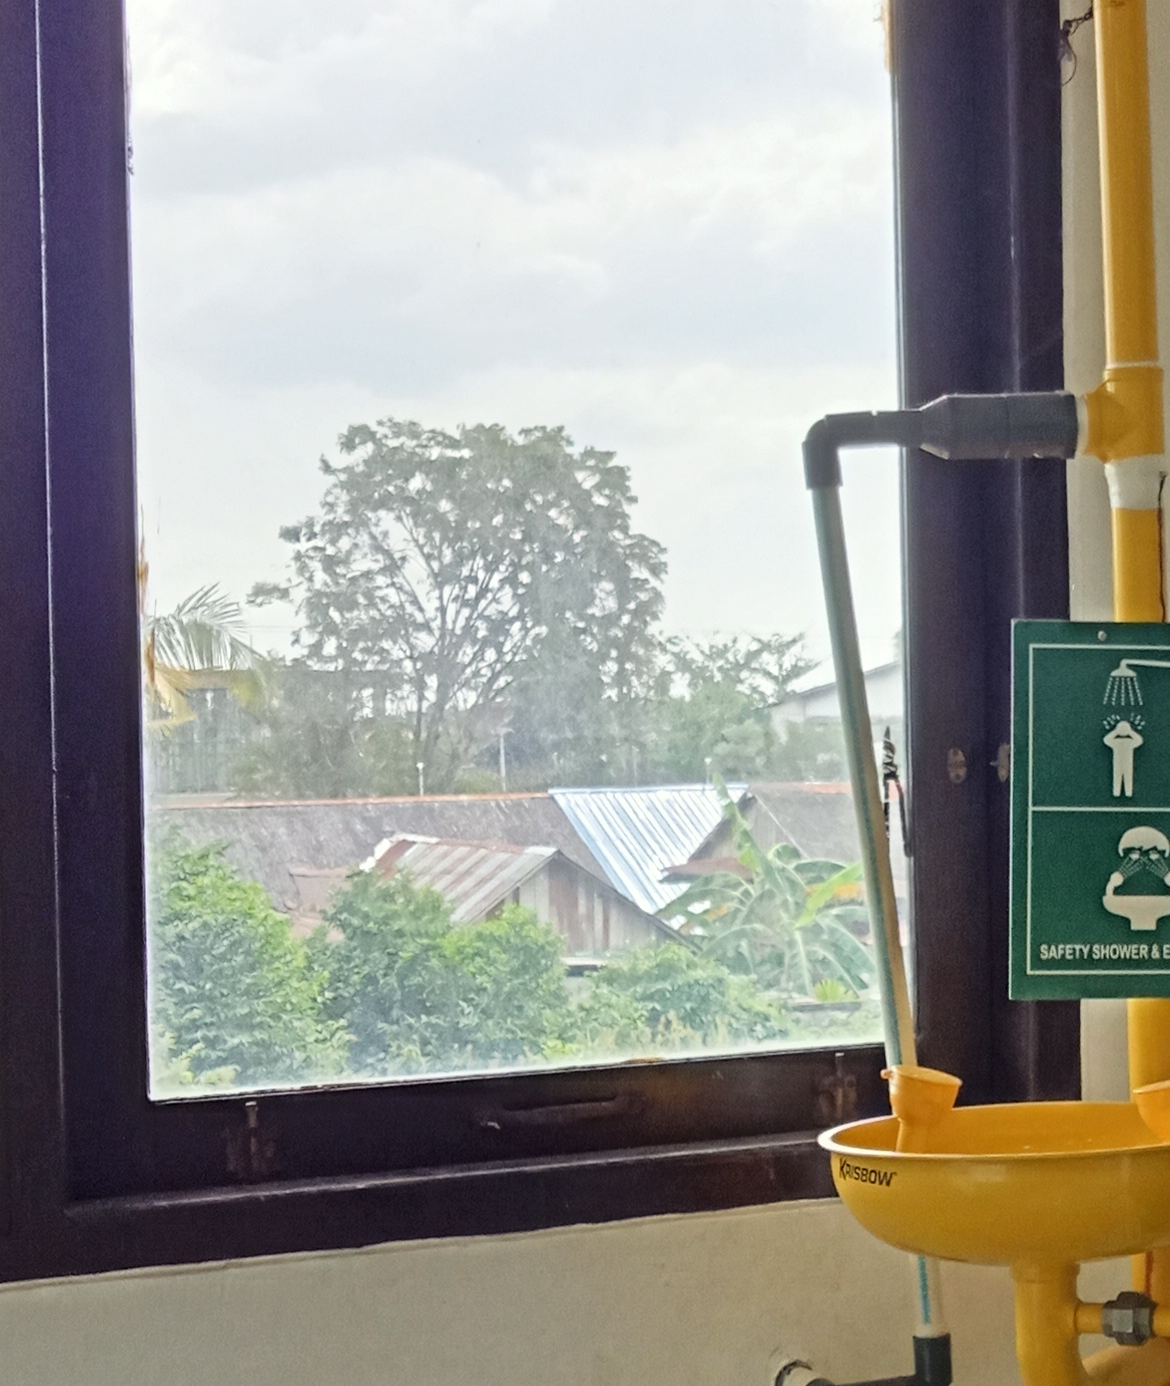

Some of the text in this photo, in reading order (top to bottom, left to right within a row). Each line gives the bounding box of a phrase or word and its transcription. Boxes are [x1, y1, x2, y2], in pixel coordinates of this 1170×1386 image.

[1039, 943, 1091, 960] SAFETY
[1092, 943, 1149, 960] SHOWER
[1151, 943, 1161, 960] &
[839, 1157, 894, 1187] KRISBOW
